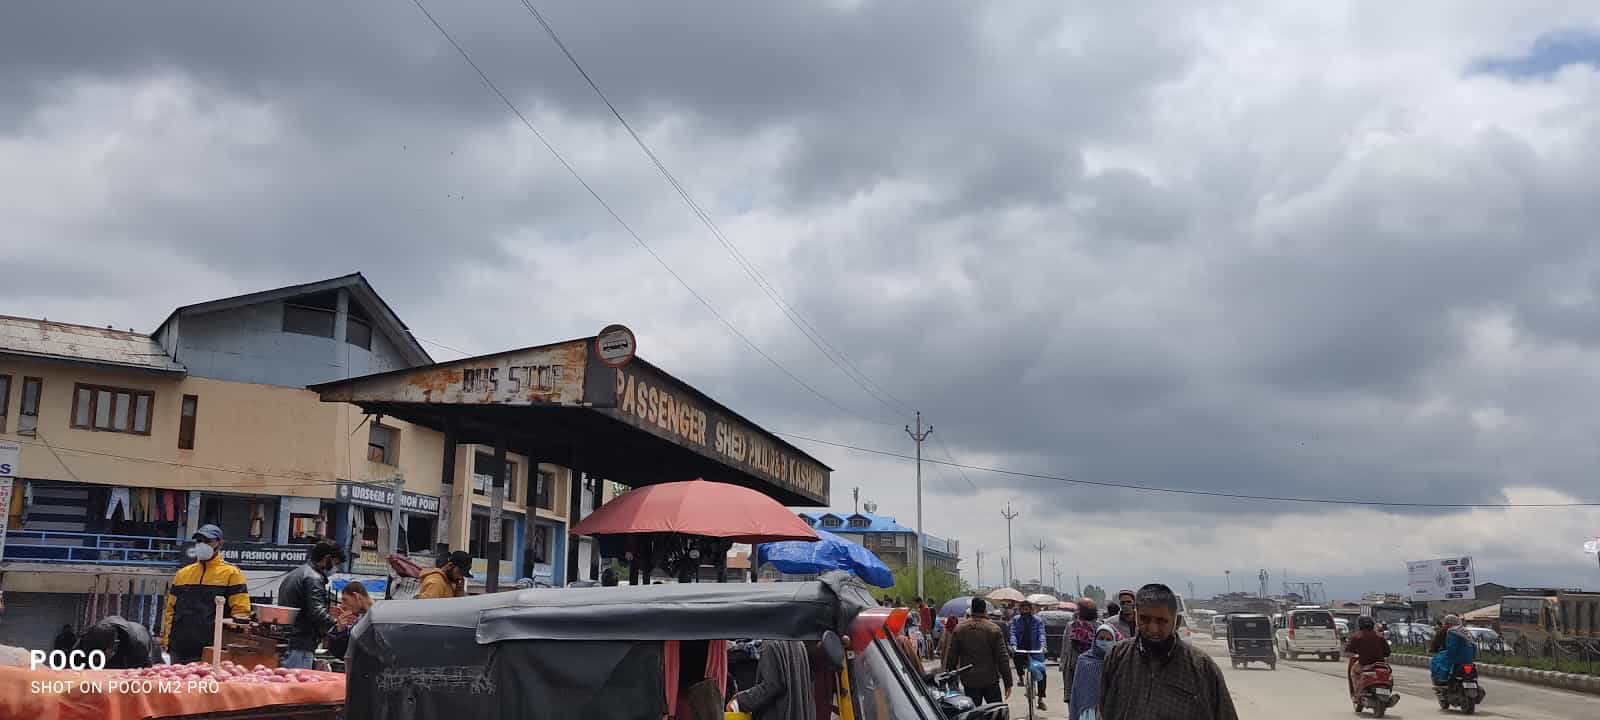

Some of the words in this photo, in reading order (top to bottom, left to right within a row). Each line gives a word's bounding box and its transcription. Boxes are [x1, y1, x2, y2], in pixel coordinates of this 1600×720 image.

[616, 366, 707, 447] PASSENGER
[715, 421, 747, 462] SHED
[789, 458, 824, 497] KASHMIR
[351, 485, 386, 503] WASEEM
[418, 497, 440, 512] POINT
[240, 550, 279, 560] FASHION
[280, 551, 308, 561] POINT
